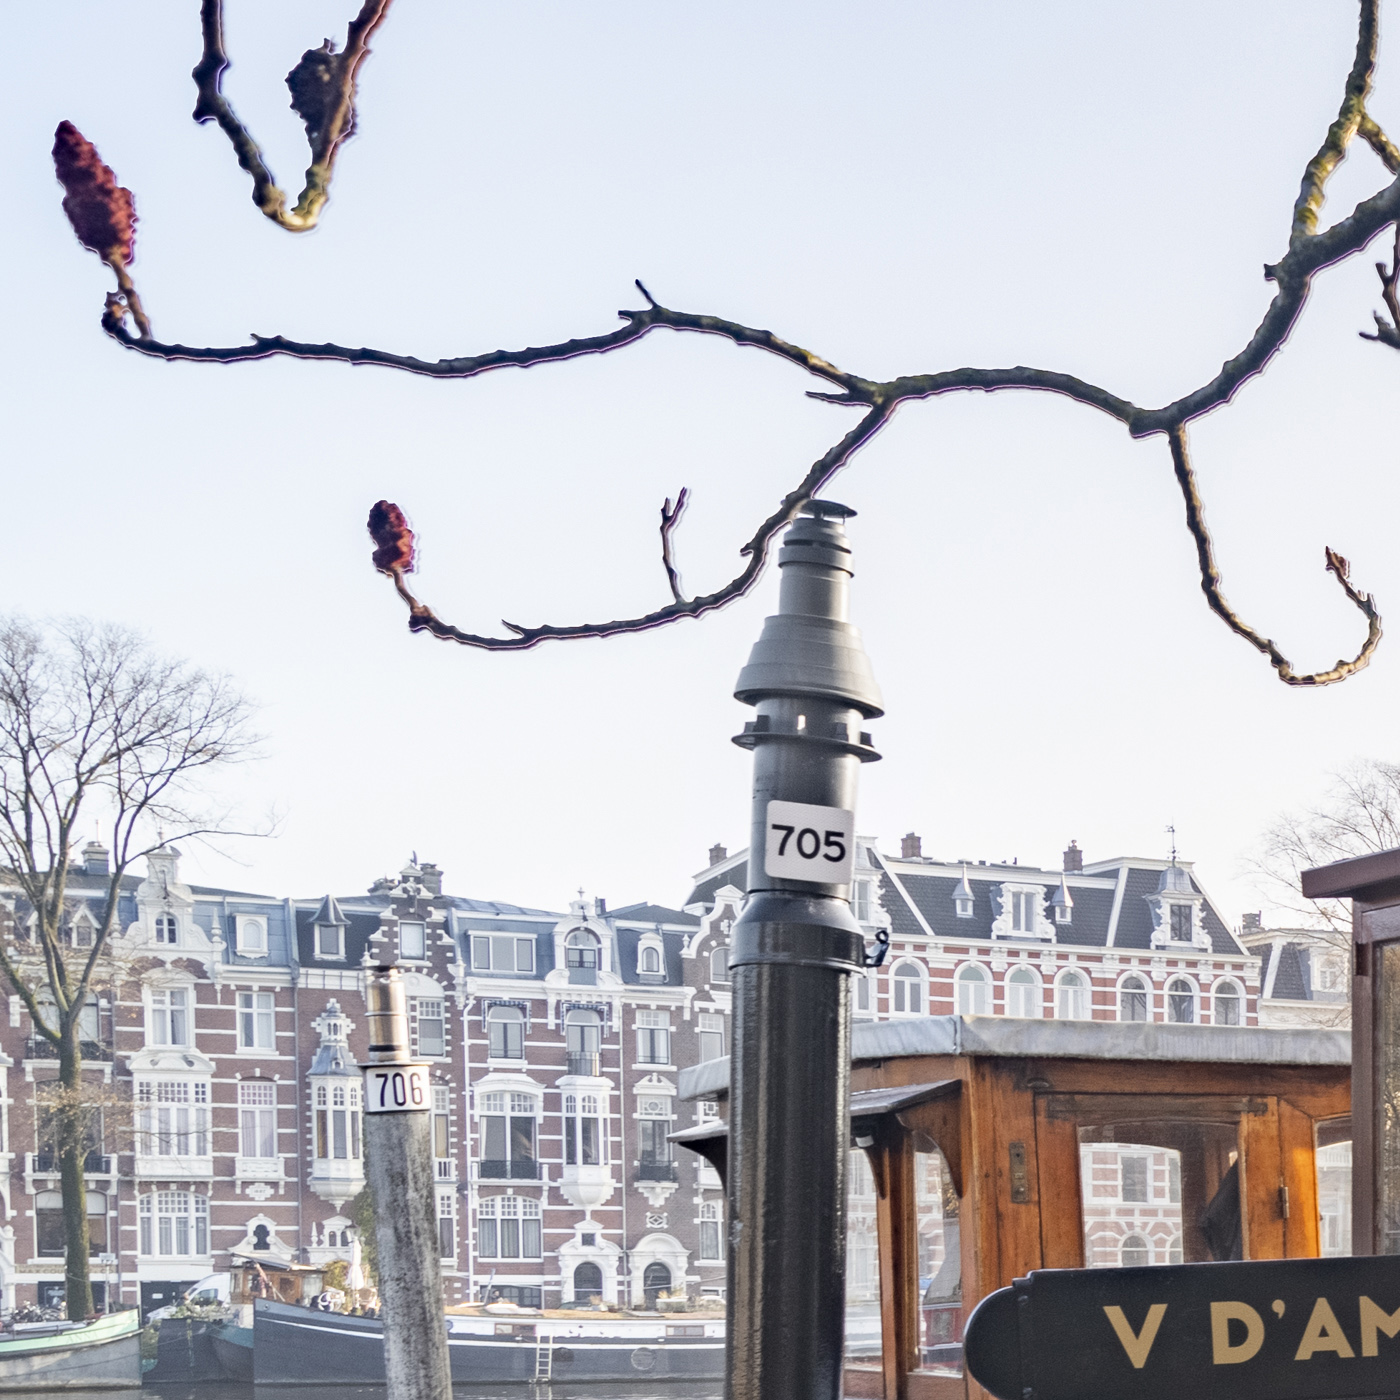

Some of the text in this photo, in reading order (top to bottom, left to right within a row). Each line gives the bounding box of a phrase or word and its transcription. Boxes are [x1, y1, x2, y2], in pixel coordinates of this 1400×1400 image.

[771, 823, 846, 863] 705
[375, 1072, 423, 1107] 706
[1103, 1303, 1168, 1369] V
